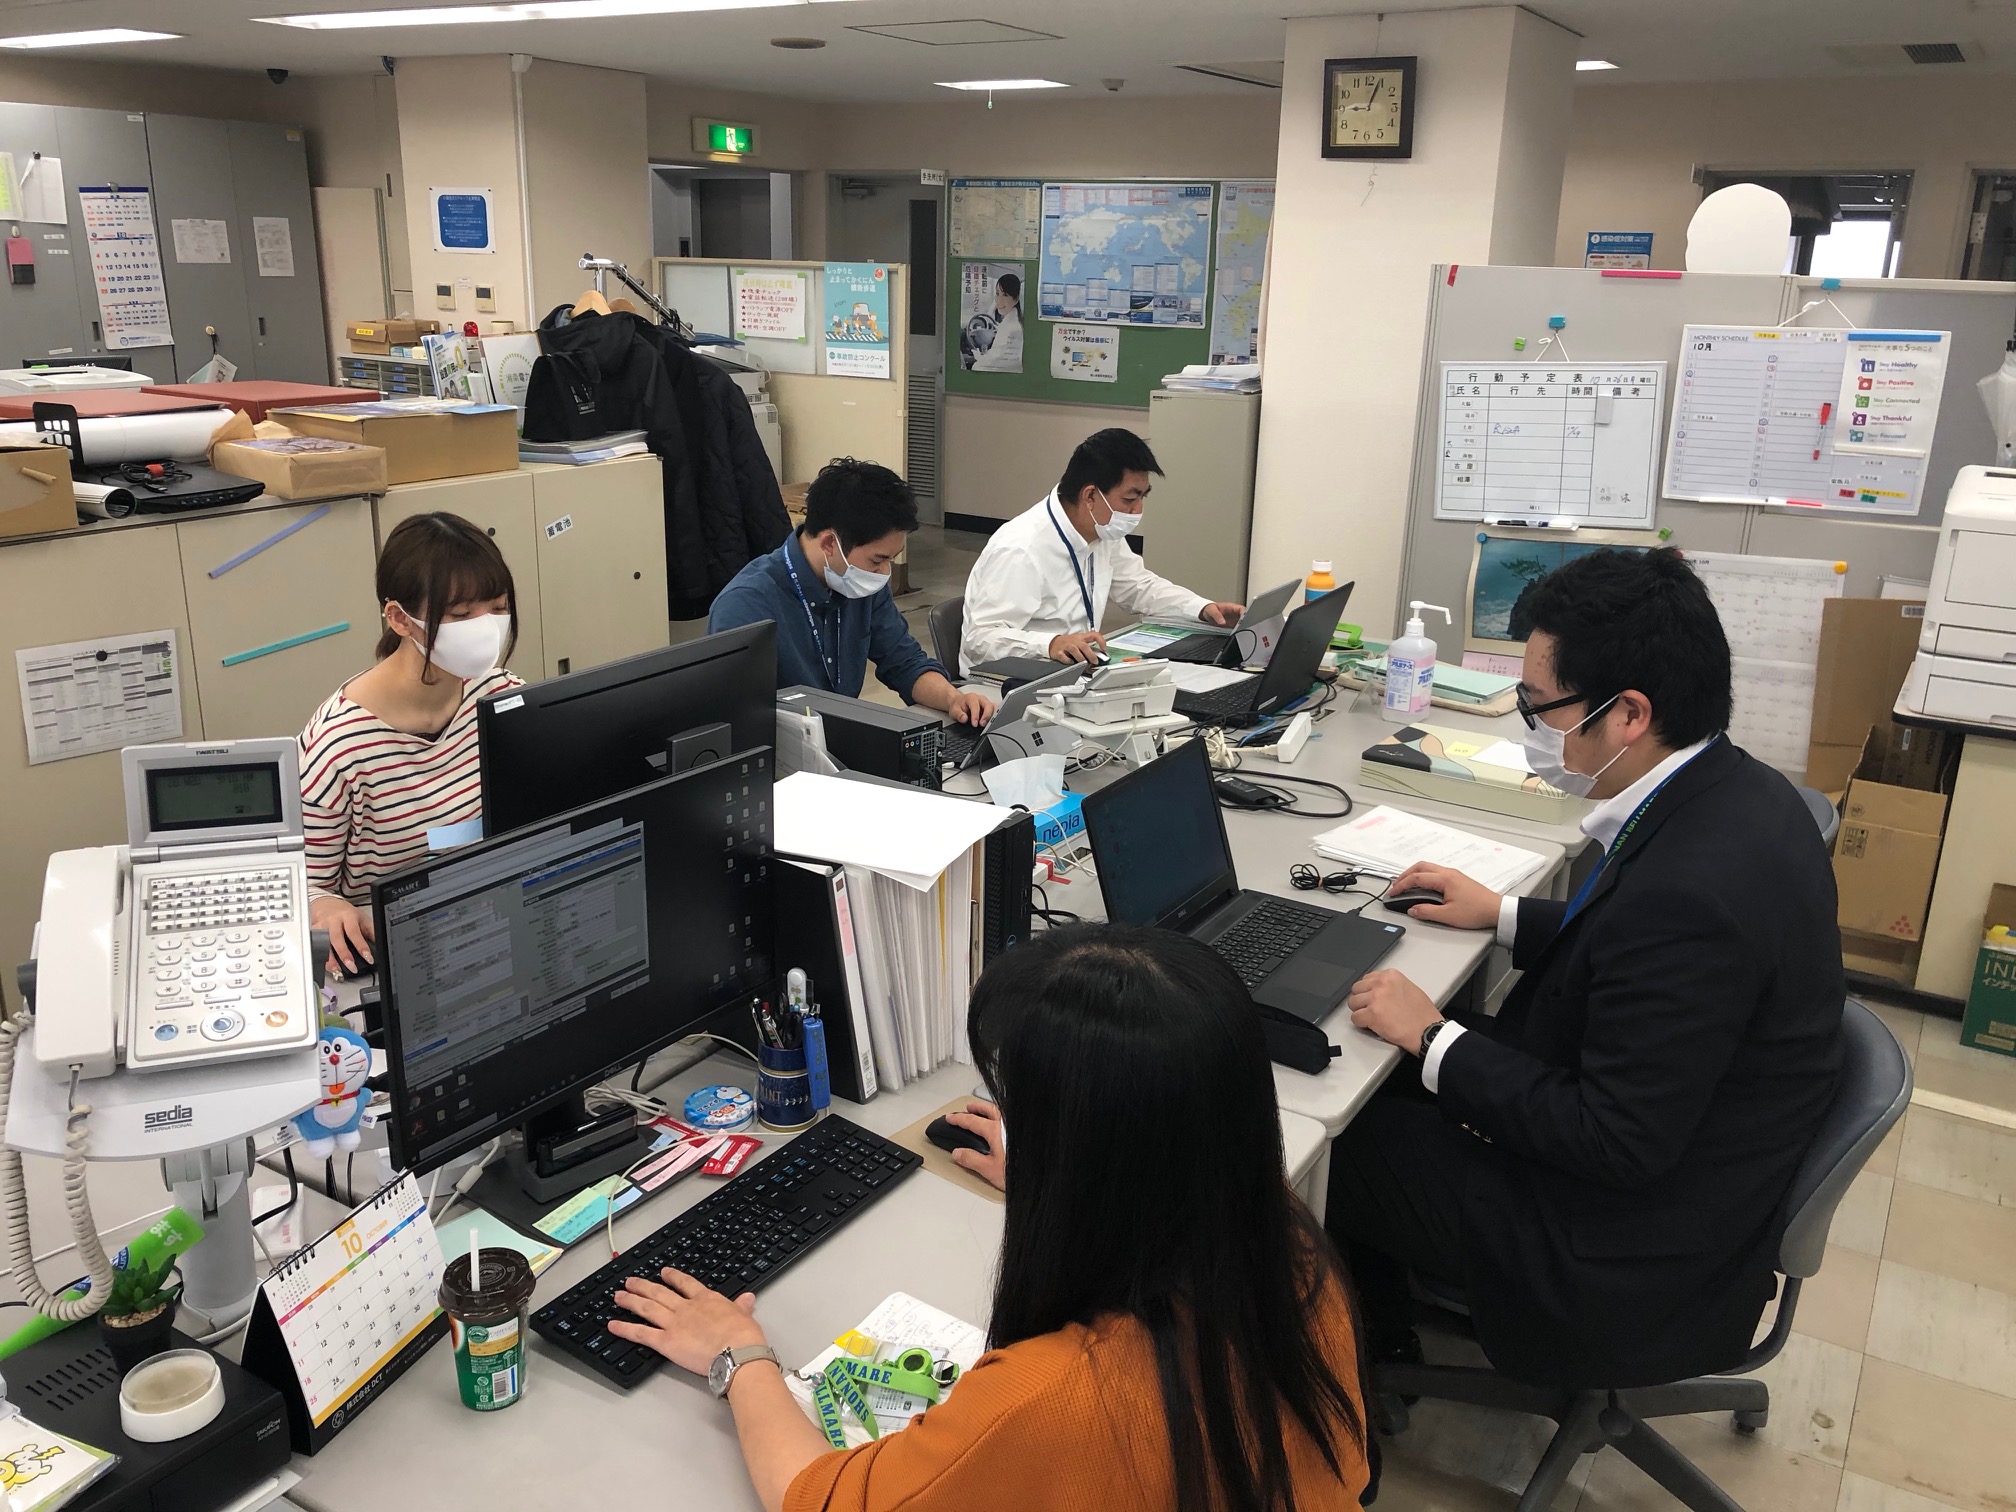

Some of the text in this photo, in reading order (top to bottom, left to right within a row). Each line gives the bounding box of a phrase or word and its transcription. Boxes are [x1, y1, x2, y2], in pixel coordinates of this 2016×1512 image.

[1354, 78, 1359, 88] 11
[1365, 76, 1374, 85] 12
[1341, 90, 1350, 99] 10
[1388, 87, 1395, 96] 2
[1339, 105, 1345, 114] 9
[1391, 103, 1398, 112] 3
[1341, 120, 1347, 129] 8
[1387, 118, 1394, 127] 4
[1353, 130, 1358, 139] 7
[1363, 131, 1370, 140] 6
[1377, 129, 1384, 139] 5
[827, 267, 852, 275] しっかりと
[851, 284, 876, 292] 横断歩道
[1063, 336, 1113, 344] ウイルス対策は最新に！
[1693, 343, 1712, 351] 10月
[1886, 344, 1932, 353] 大事な5つのこと
[837, 353, 885, 362] 事故防止コンクール
[1468, 373, 1583, 383] 行動予定表
[1456, 386, 1640, 396] 氏名 行先 時間 備考
[547, 518, 571, 537] 蓄電池
[1043, 814, 1080, 842] nepia
[391, 881, 420, 896] SMART
[145, 1105, 192, 1124] sedia
[144, 1123, 193, 1133] INTERNATIONAL
[366, 1219, 388, 1239] OCTOBER
[341, 1232, 363, 1259] 10
[417, 1237, 423, 1245] 10
[320, 1340, 327, 1348] 12
[342, 1321, 349, 1330] 13
[363, 1304, 370, 1312] 14
[403, 1270, 410, 1278] 16
[422, 1254, 428, 1262] 17
[304, 1271, 434, 1386] 18 19 20 21 22 23 24
[310, 1396, 318, 1406] 25
[332, 1377, 339, 1386] 26
[354, 1357, 360, 1367] 27
[374, 1339, 382, 1349] 28
[394, 1321, 401, 1330] 29
[413, 1304, 421, 1313] 30
[346, 1373, 384, 1411] 株式会社 DCT
[828, 1361, 871, 1424] SHONAN
